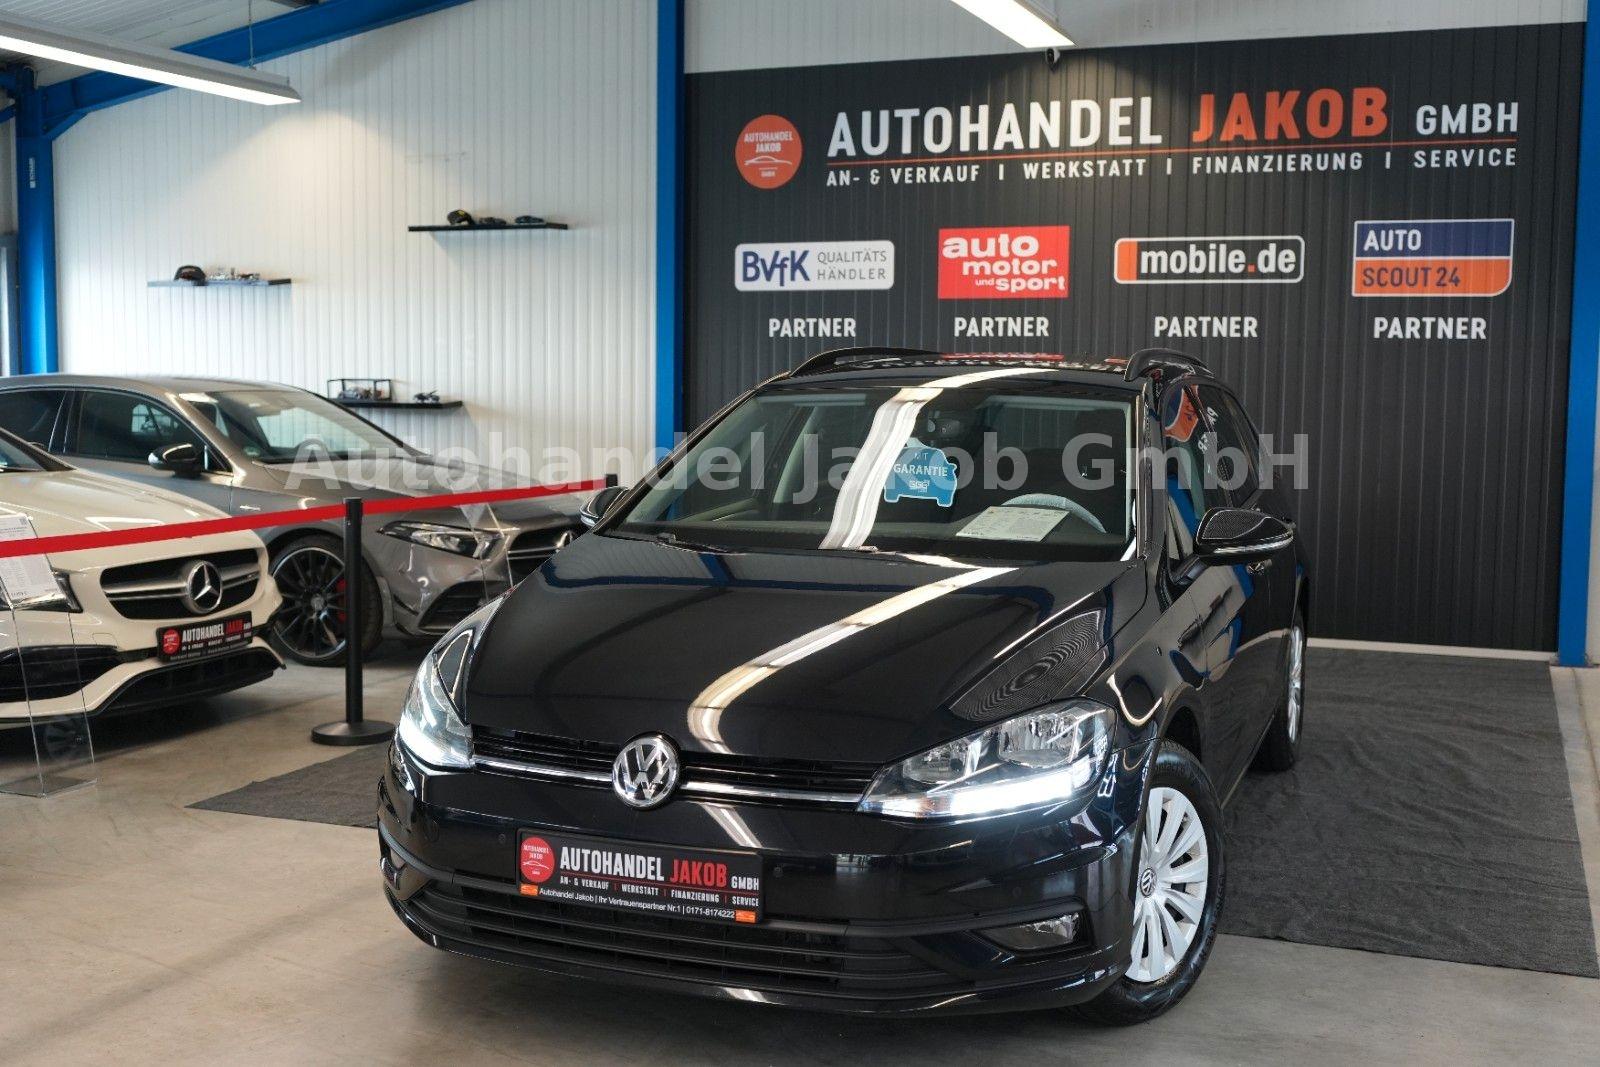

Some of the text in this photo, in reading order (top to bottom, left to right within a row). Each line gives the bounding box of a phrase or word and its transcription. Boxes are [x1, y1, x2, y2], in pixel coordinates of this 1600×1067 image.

[827, 86, 1518, 158] AUTOHANDEL JAKOB GMBH
[744, 131, 793, 143] AUTOHANDEL
[756, 142, 782, 153] JAKOB
[826, 169, 860, 187] AN-
[870, 168, 881, 185] &
[890, 164, 980, 184] VERKAUF
[1023, 158, 1147, 179] WERKSTATT
[1192, 152, 1363, 174] FINANZIERUNG
[1413, 148, 1517, 169] SERVICE
[942, 233, 1039, 258] auto
[1363, 229, 1422, 252] AUTO
[817, 248, 887, 265] QUALITÄTS
[962, 258, 1058, 277] motor
[1140, 243, 1296, 274] mobile.de
[742, 250, 811, 287] BVfK
[817, 267, 886, 281] HÄNDLER
[1363, 268, 1461, 287] SCOUT 24
[976, 276, 1066, 293] und sport
[769, 318, 857, 338] PARTNER
[954, 316, 1050, 338] PARTNER
[1154, 316, 1258, 338] PARTNER
[1374, 317, 1487, 340] PARTNER
[893, 463, 948, 477] GARANTIE
[182, 623, 225, 642] AUTOHANDEL
[560, 846, 760, 892] AUTOHANDEL JAKOB GMBH
[539, 888, 575, 900] Autohandel
[575, 893, 594, 902] Jakob
[598, 896, 608, 904] Ihr
[608, 897, 666, 912] Vertrauenspartner
[686, 905, 735, 919] 0171-8174222
[582, 879, 609, 890] VERKAUF
[621, 884, 660, 897] WERKSTATT
[671, 889, 720, 904] FINANZIERUNG
[732, 896, 760, 908] SERVICE
